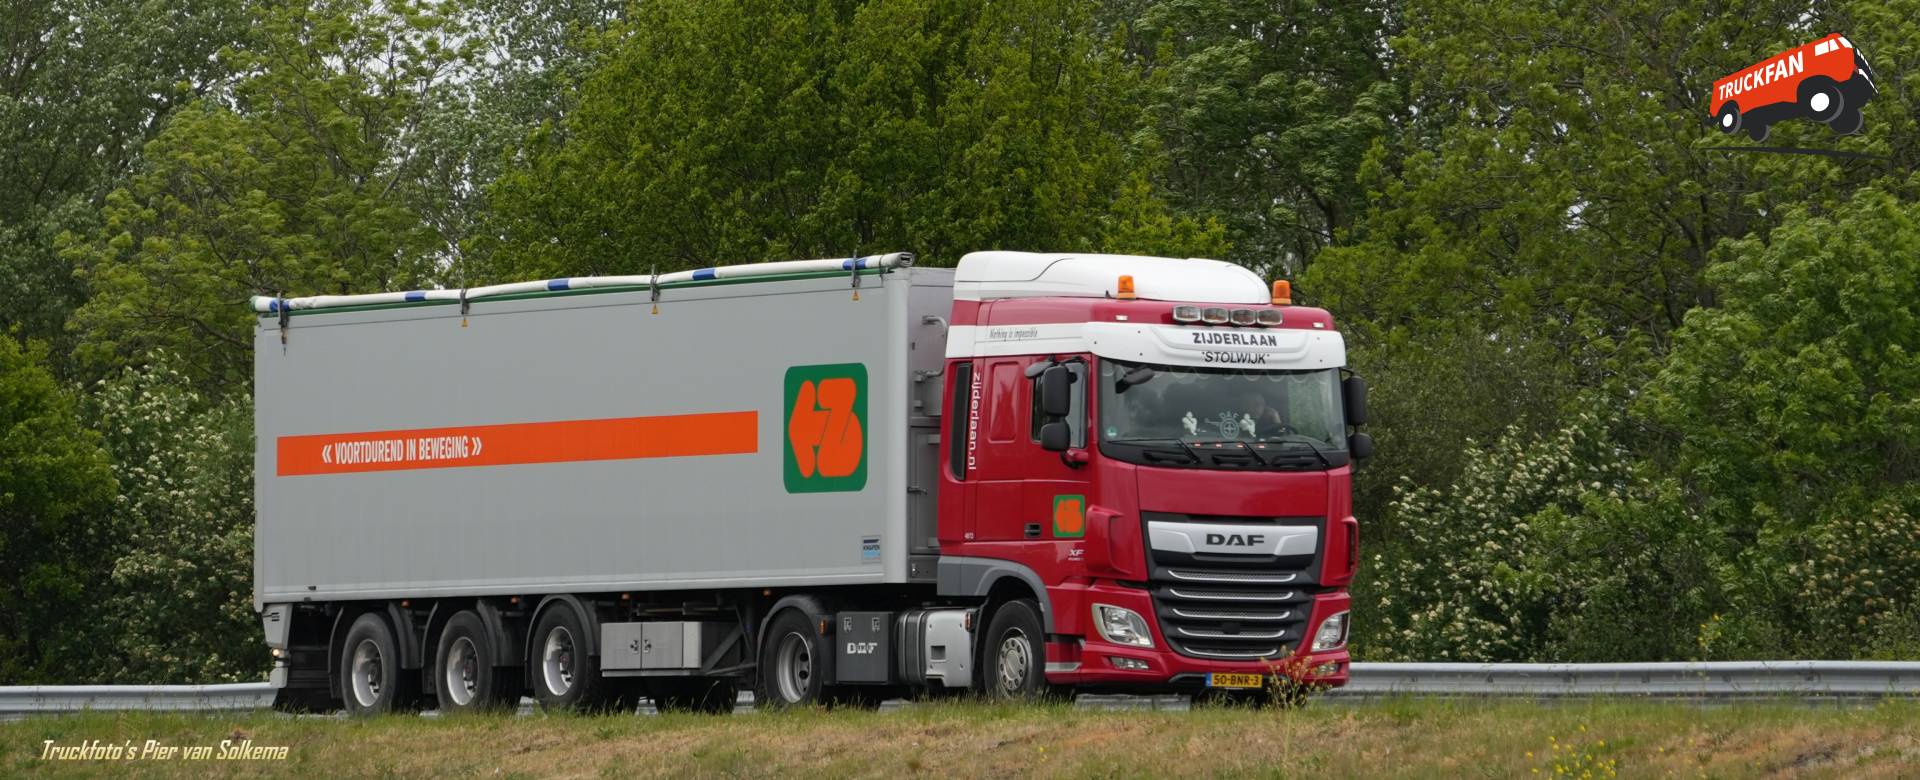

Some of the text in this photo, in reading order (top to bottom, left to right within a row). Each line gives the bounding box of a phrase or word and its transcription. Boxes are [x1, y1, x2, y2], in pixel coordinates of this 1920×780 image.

[1192, 332, 1277, 346] ZIJDERLAAN
[968, 372, 982, 470] zijderlaan.nl
[335, 435, 469, 464] VOORTDUREND IN BEWEGING
[1206, 533, 1265, 547] DAF
[1068, 548, 1084, 557] XF
[847, 642, 878, 654] DAF
[1214, 674, 1259, 686] 50-BNR-3
